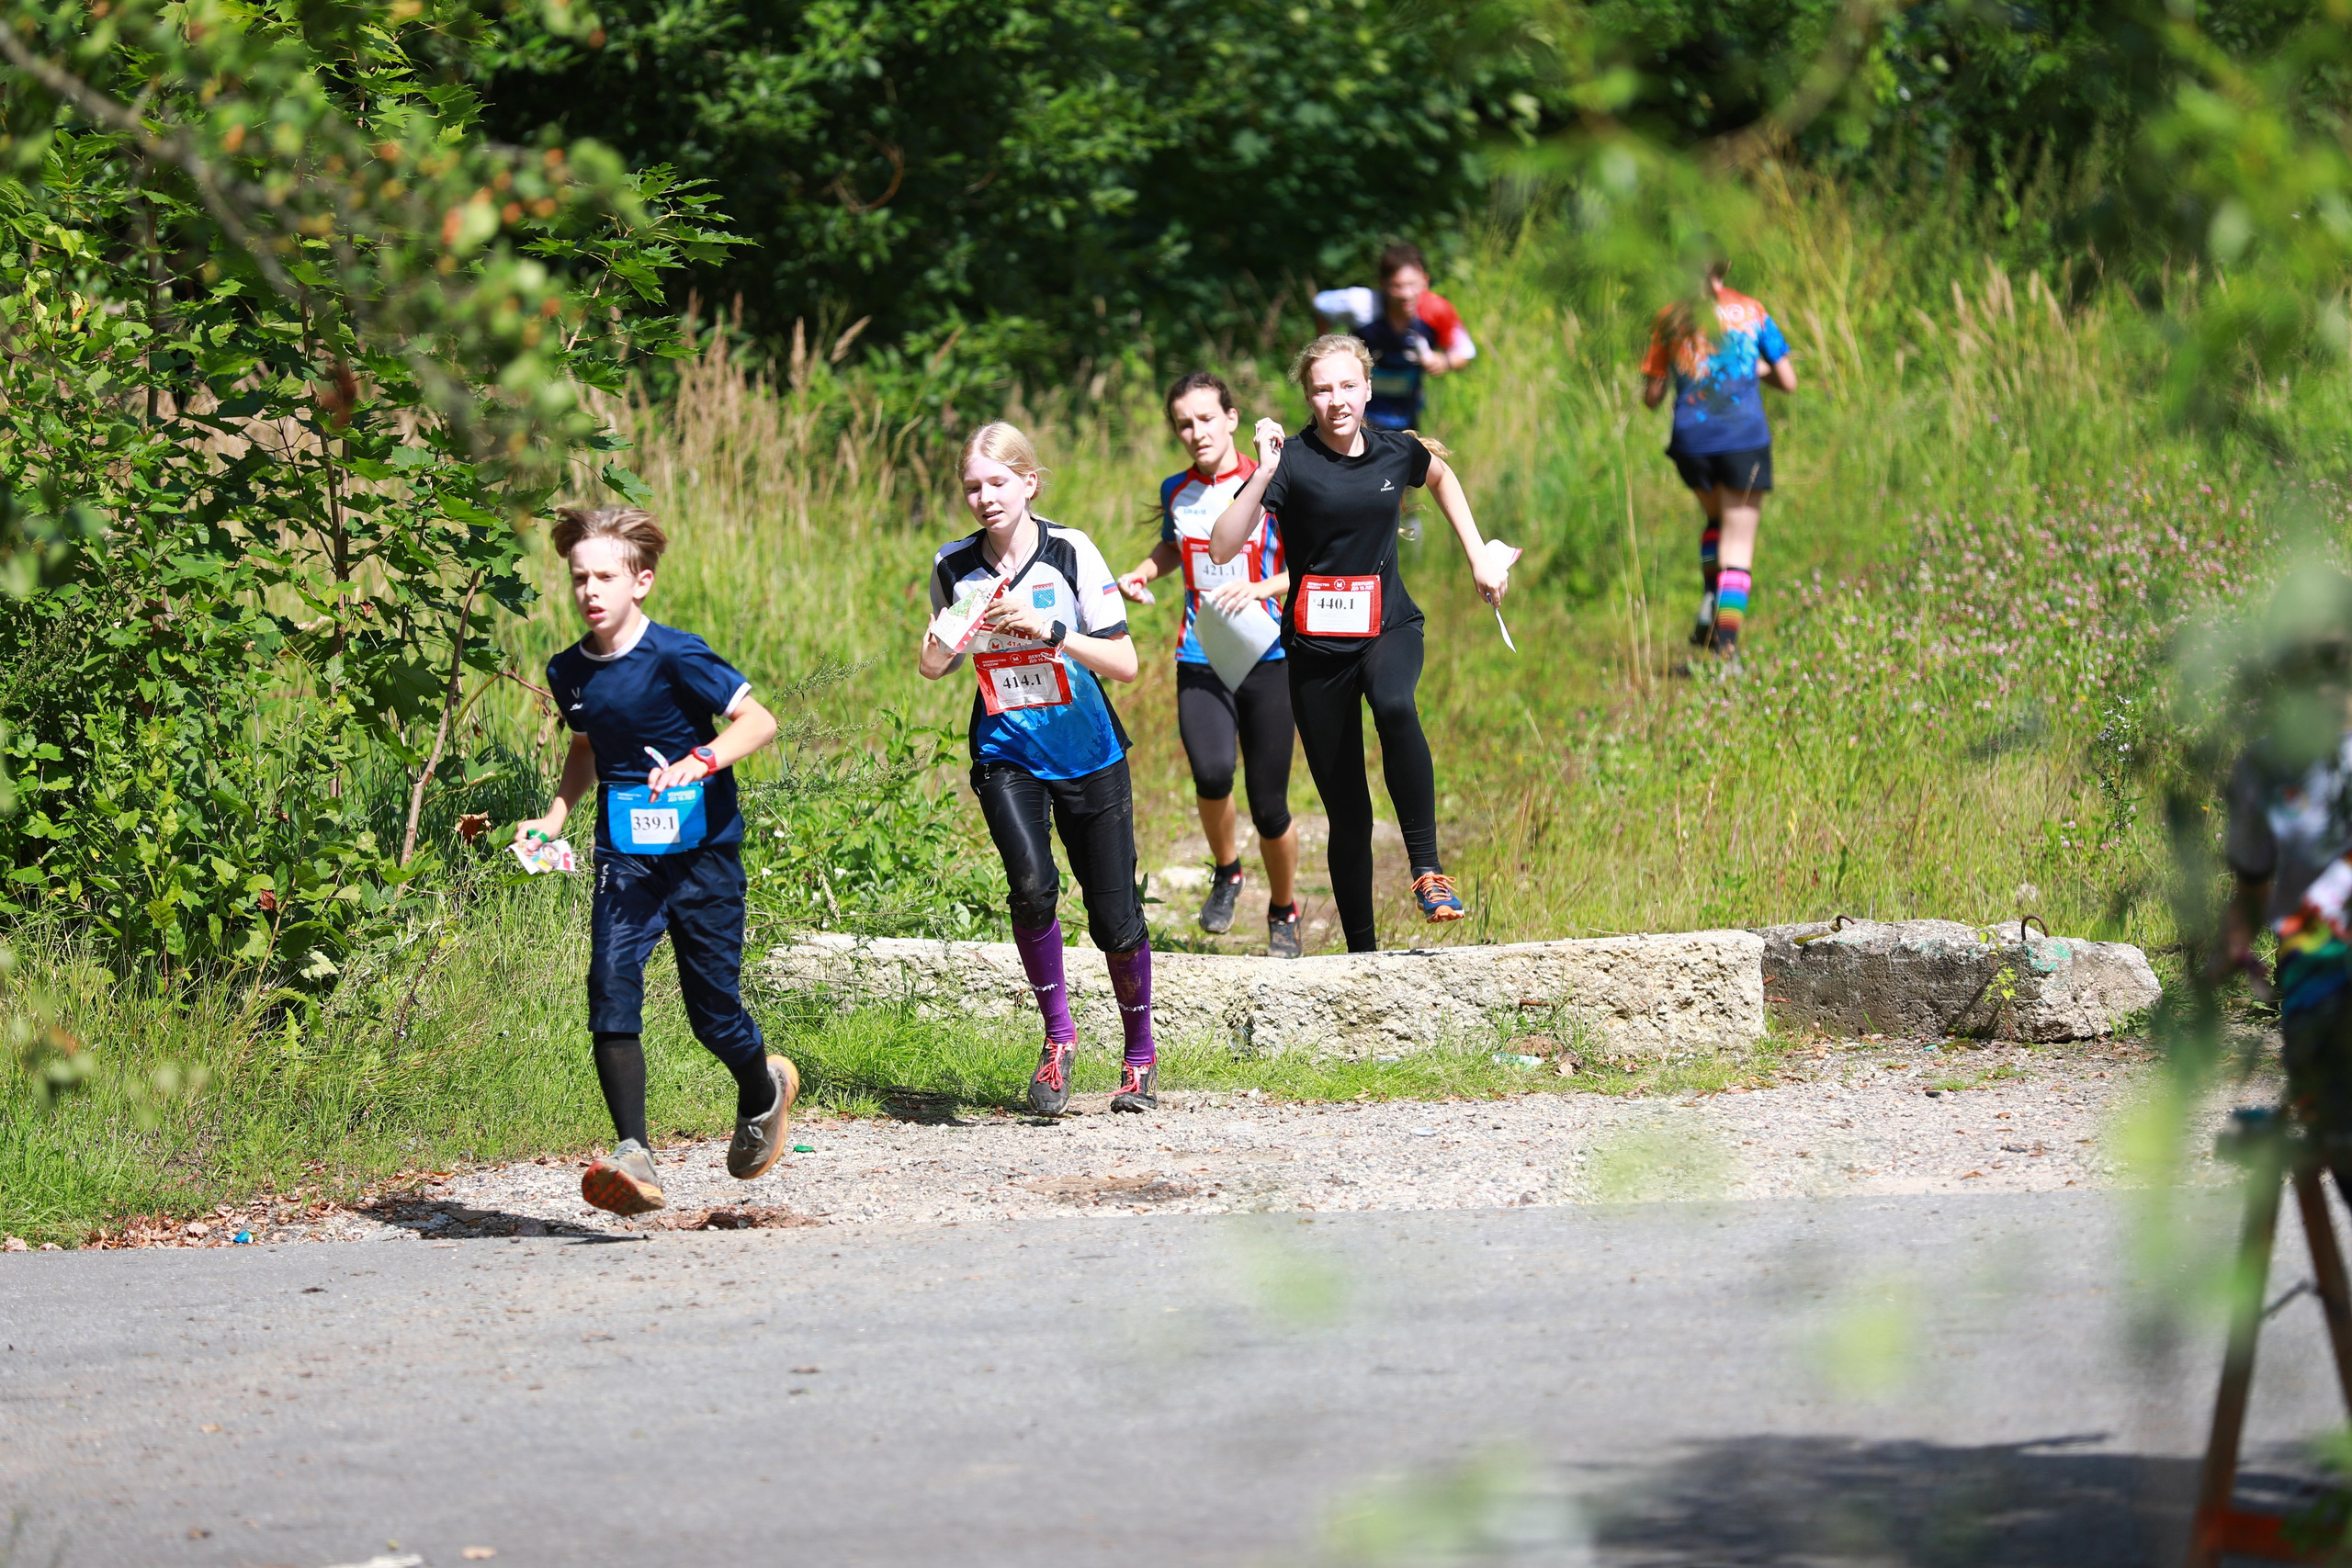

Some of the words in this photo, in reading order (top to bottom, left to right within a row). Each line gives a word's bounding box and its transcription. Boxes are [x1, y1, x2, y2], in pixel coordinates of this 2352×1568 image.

[1203, 565, 1235, 576] 421.1
[1317, 598, 1354, 610] 440.1
[1002, 673, 1042, 689] 414.1
[632, 816, 675, 831] 339.1
